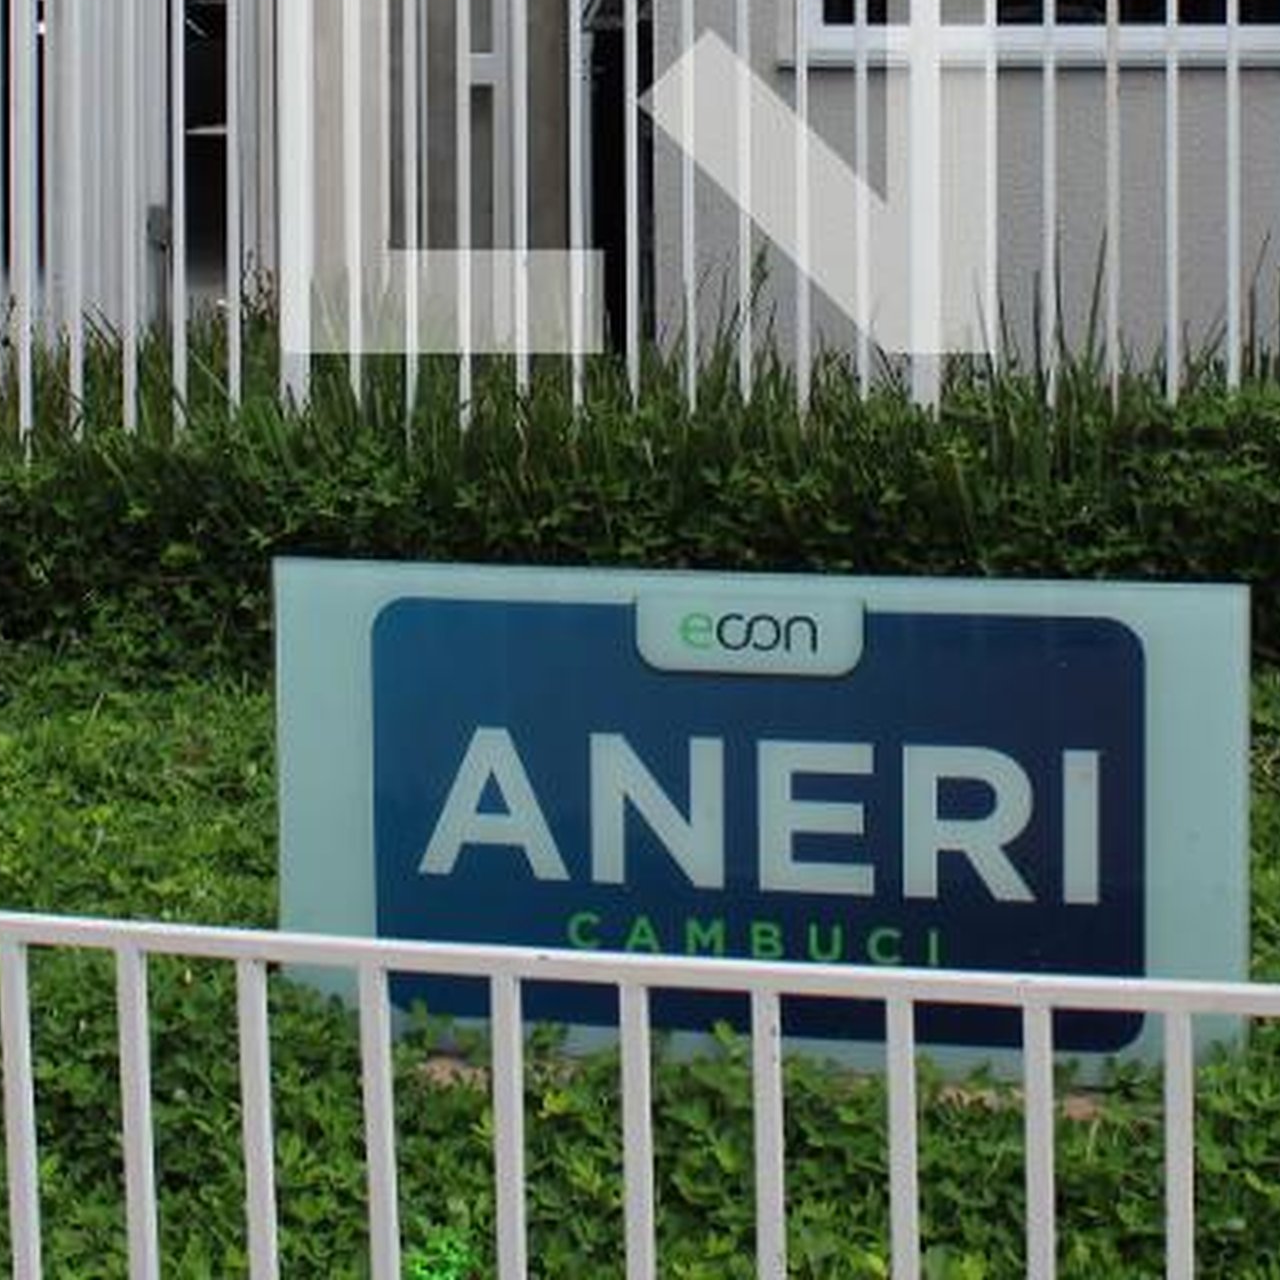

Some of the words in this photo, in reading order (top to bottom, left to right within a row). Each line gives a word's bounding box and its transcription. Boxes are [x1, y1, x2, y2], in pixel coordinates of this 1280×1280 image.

[679, 612, 818, 653] econ
[418, 725, 1101, 904] ANERI
[567, 911, 941, 966] CAMBUCI
